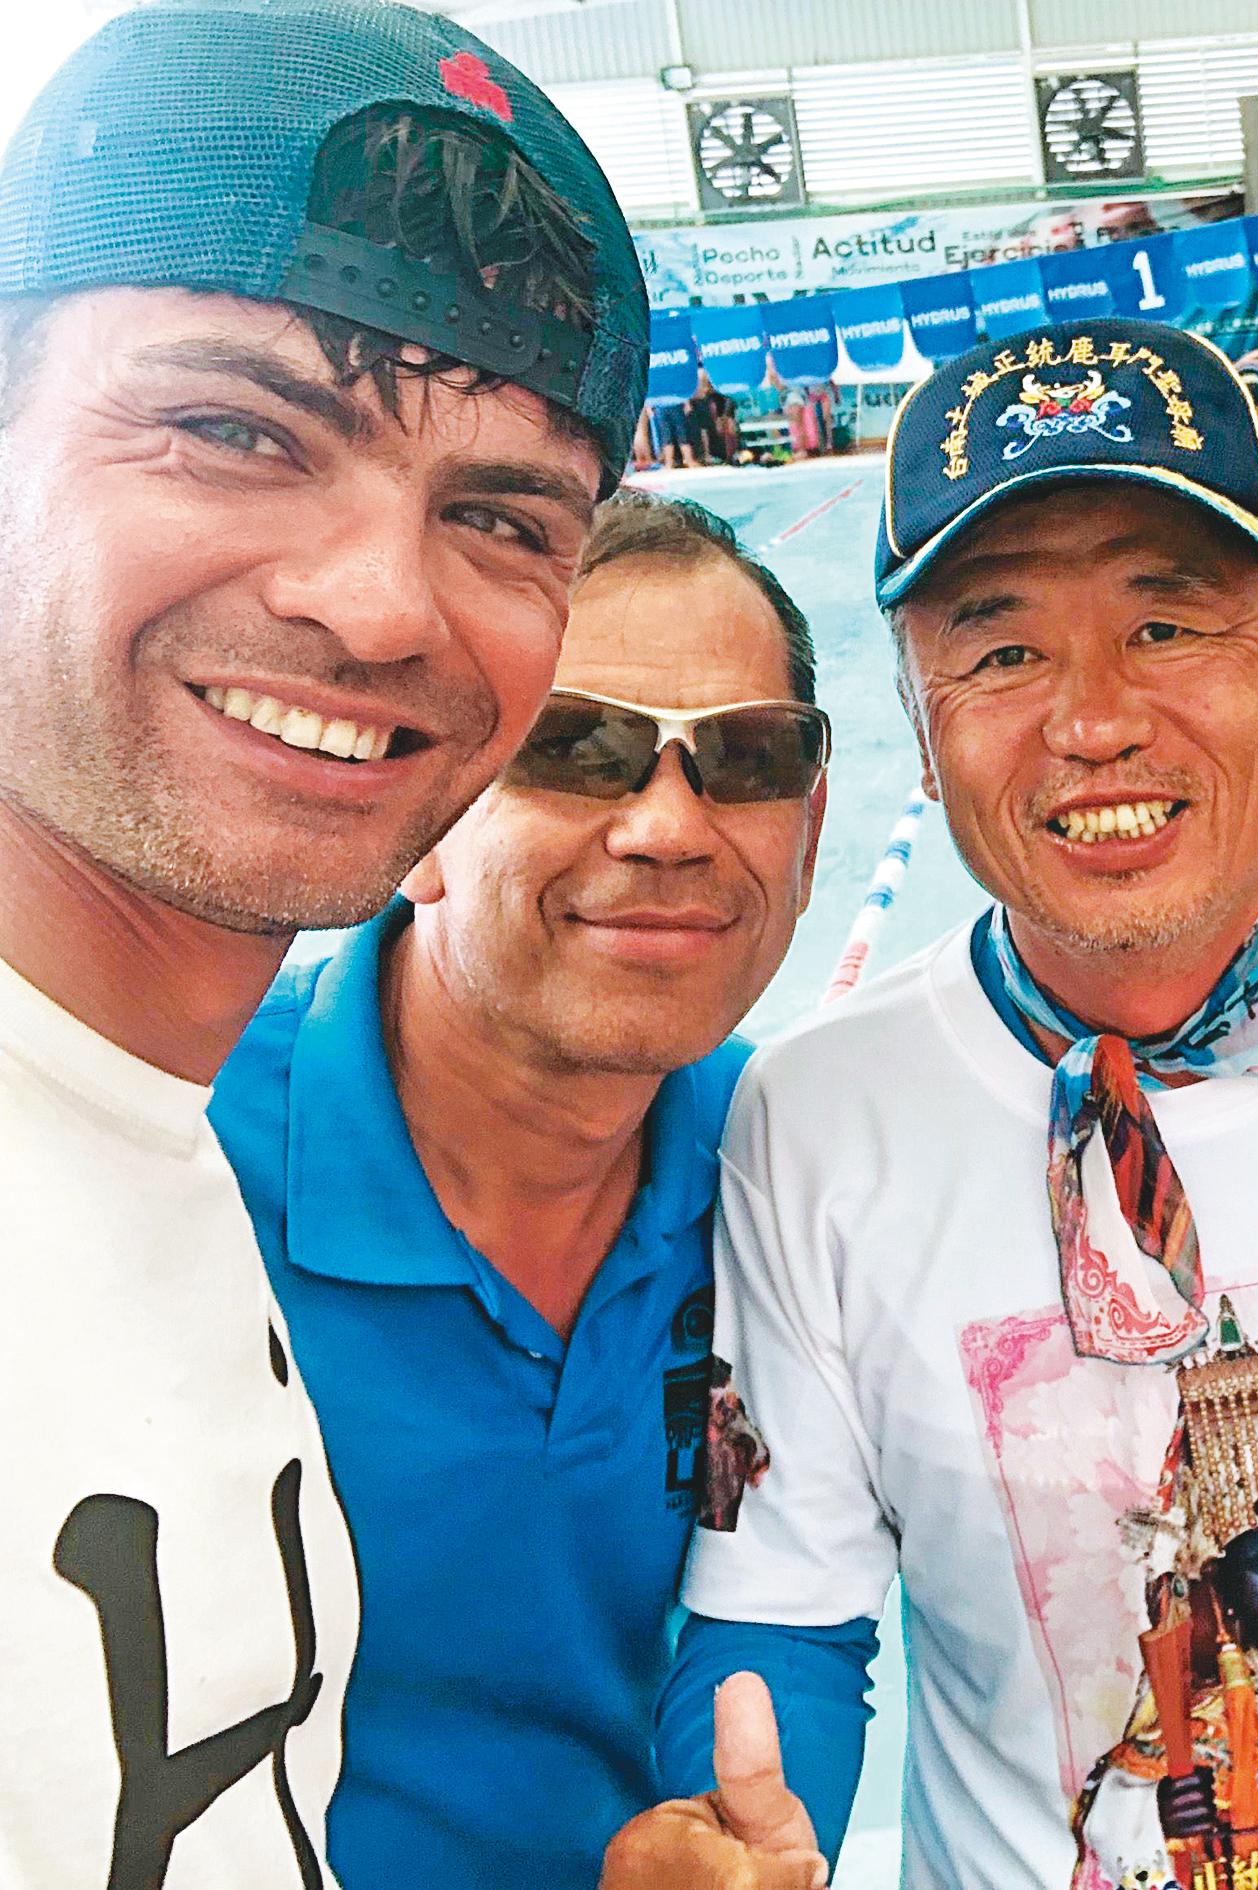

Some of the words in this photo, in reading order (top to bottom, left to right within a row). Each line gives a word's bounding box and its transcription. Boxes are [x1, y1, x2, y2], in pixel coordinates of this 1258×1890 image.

[813, 230, 936, 260] Actitud
[649, 349, 689, 369] DRUS
[701, 336, 761, 358] HYDRUS
[769, 327, 830, 349] HYDRUS
[841, 317, 902, 340] HYDRUS
[911, 306, 971, 327] HYDRUS
[980, 293, 1041, 315] HYDRUS
[1048, 280, 1110, 302] HYDRUS
[1132, 251, 1165, 310] 1
[1185, 253, 1246, 278] HYDRUS
